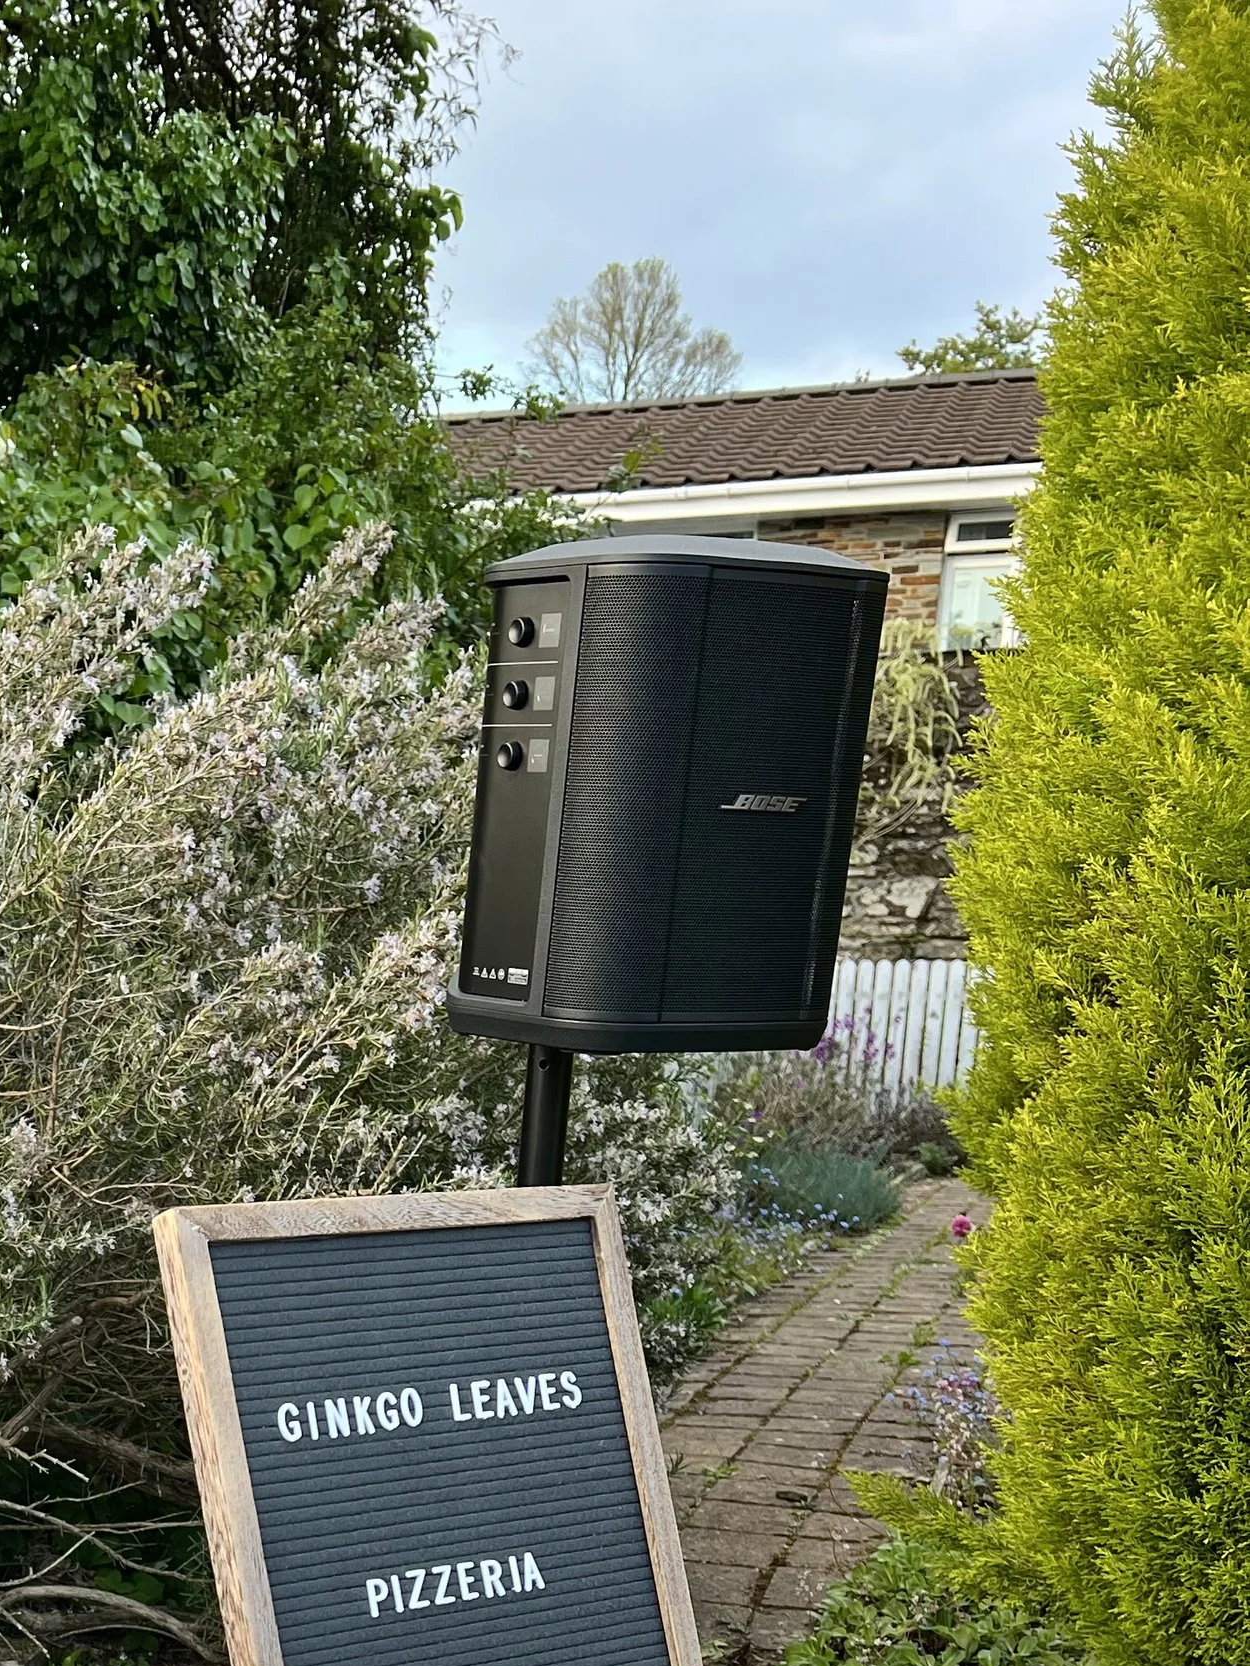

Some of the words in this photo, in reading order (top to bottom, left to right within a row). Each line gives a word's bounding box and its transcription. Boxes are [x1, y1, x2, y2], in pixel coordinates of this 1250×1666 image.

[720, 794, 807, 812] BOSE
[277, 1387, 424, 1442] GINKGO
[449, 1371, 583, 1421] LEAVES
[365, 1552, 546, 1618] PIZZERIA
